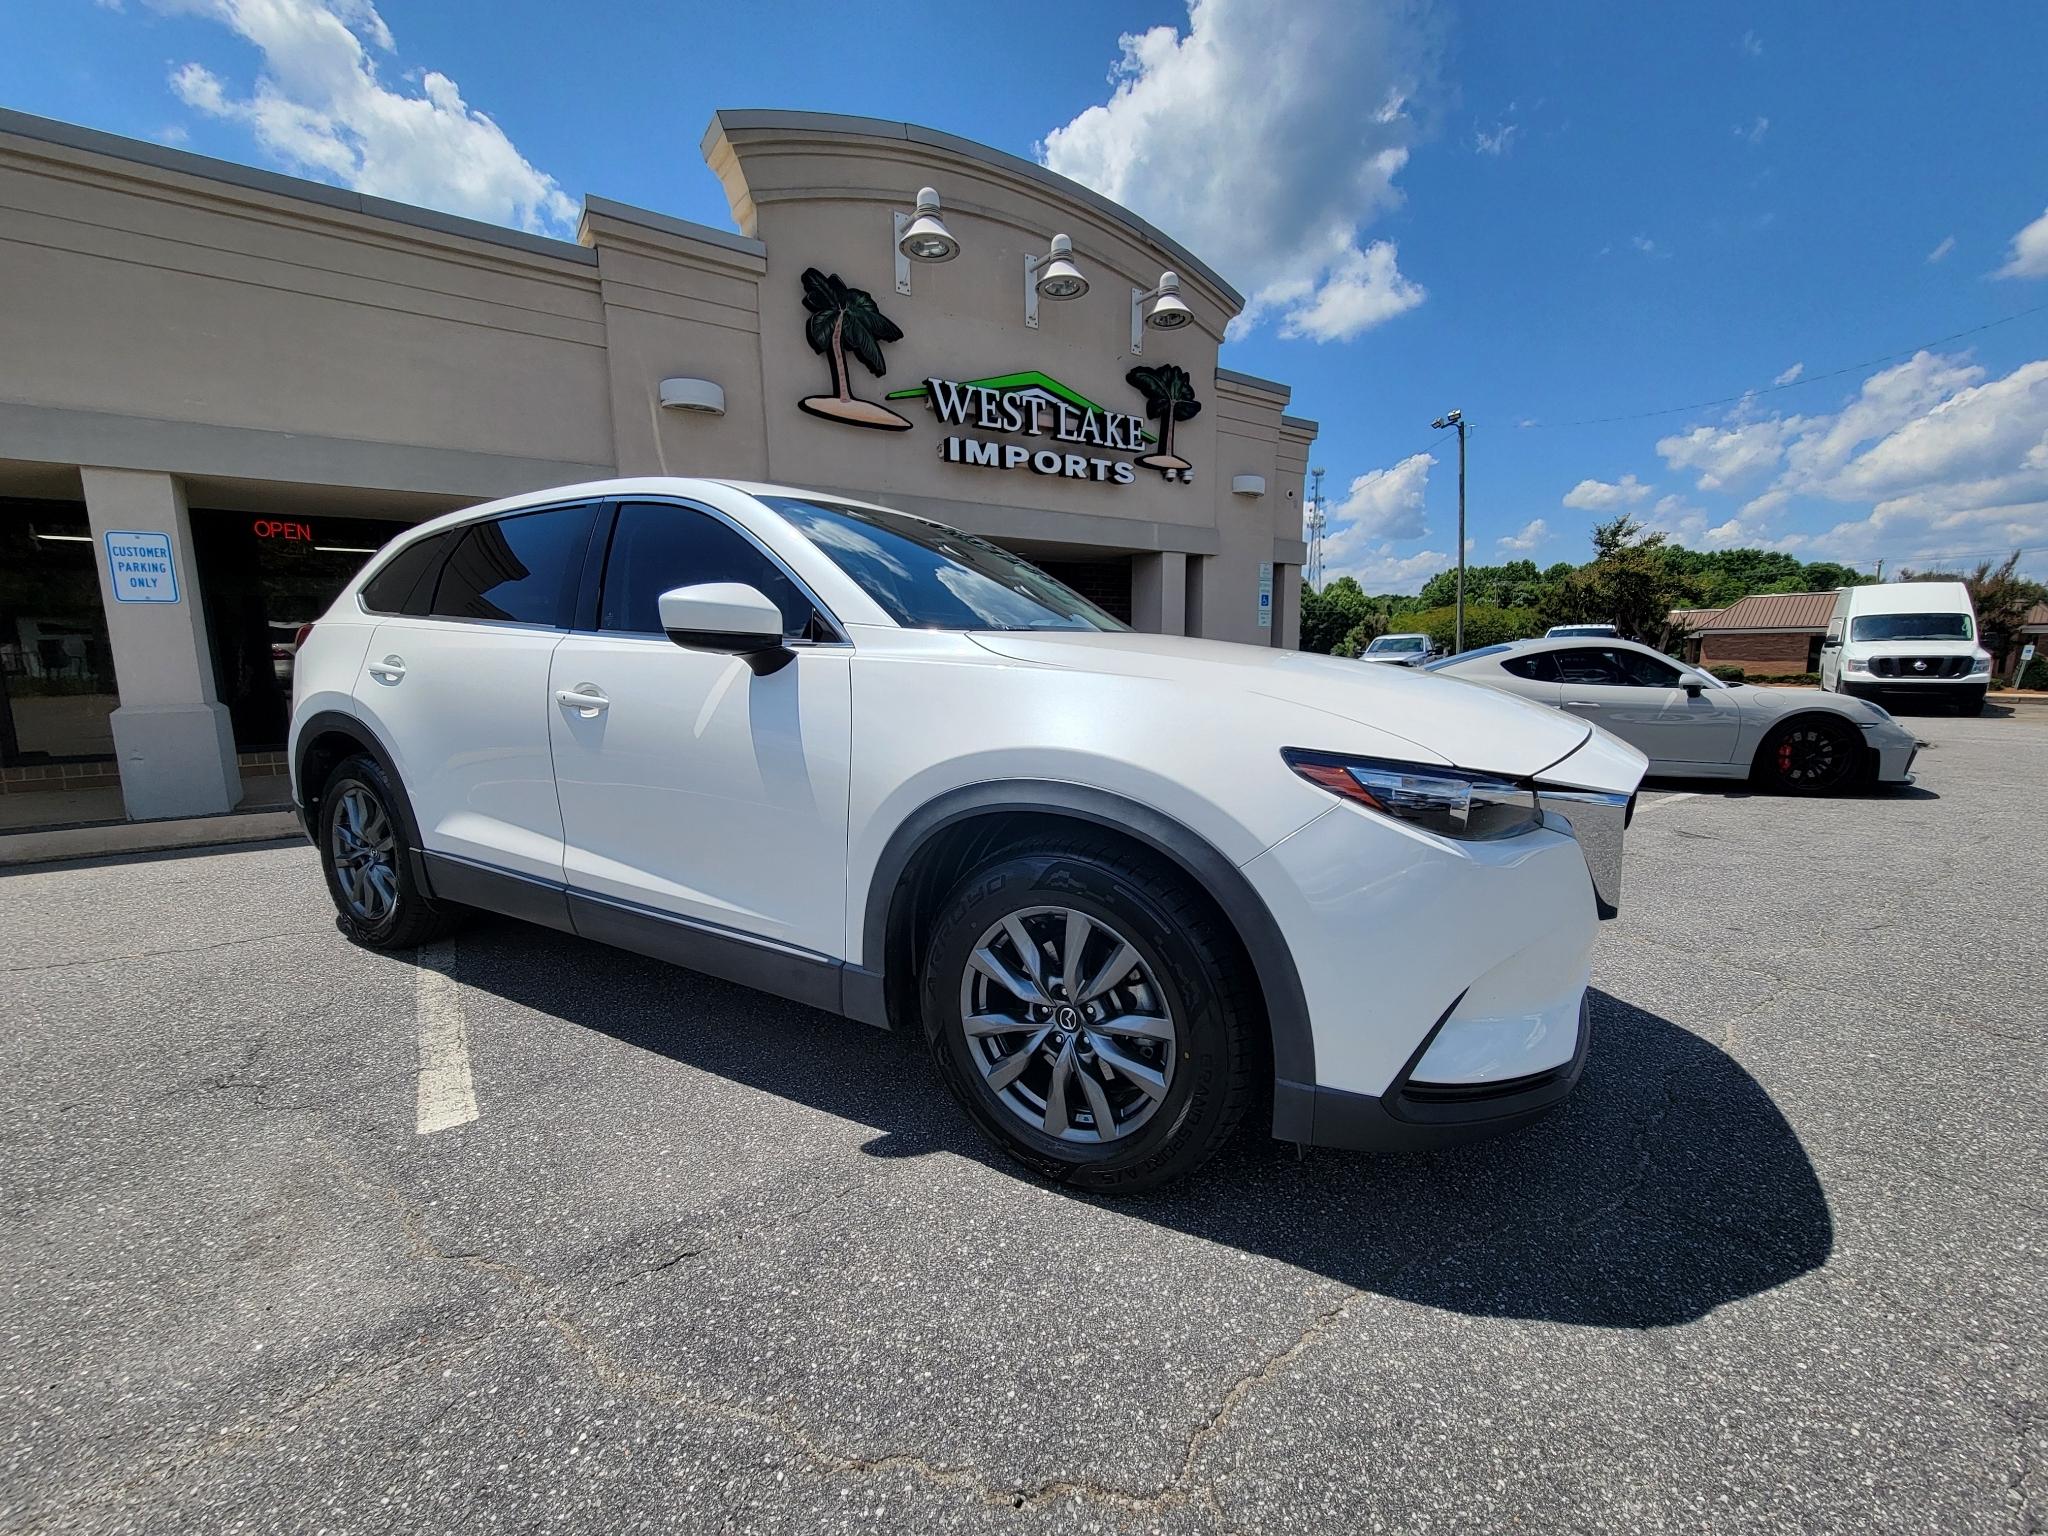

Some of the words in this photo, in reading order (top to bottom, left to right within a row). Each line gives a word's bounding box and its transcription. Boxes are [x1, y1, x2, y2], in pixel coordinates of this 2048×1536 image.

[928, 377, 1047, 434] WEST
[1056, 402, 1146, 451] LAKE
[948, 436, 1136, 483] IMPORTS
[254, 520, 311, 541] OPEN
[112, 546, 167, 558] CUSTOMER
[118, 562, 166, 573] PARKING
[130, 577, 157, 588] ONLY
